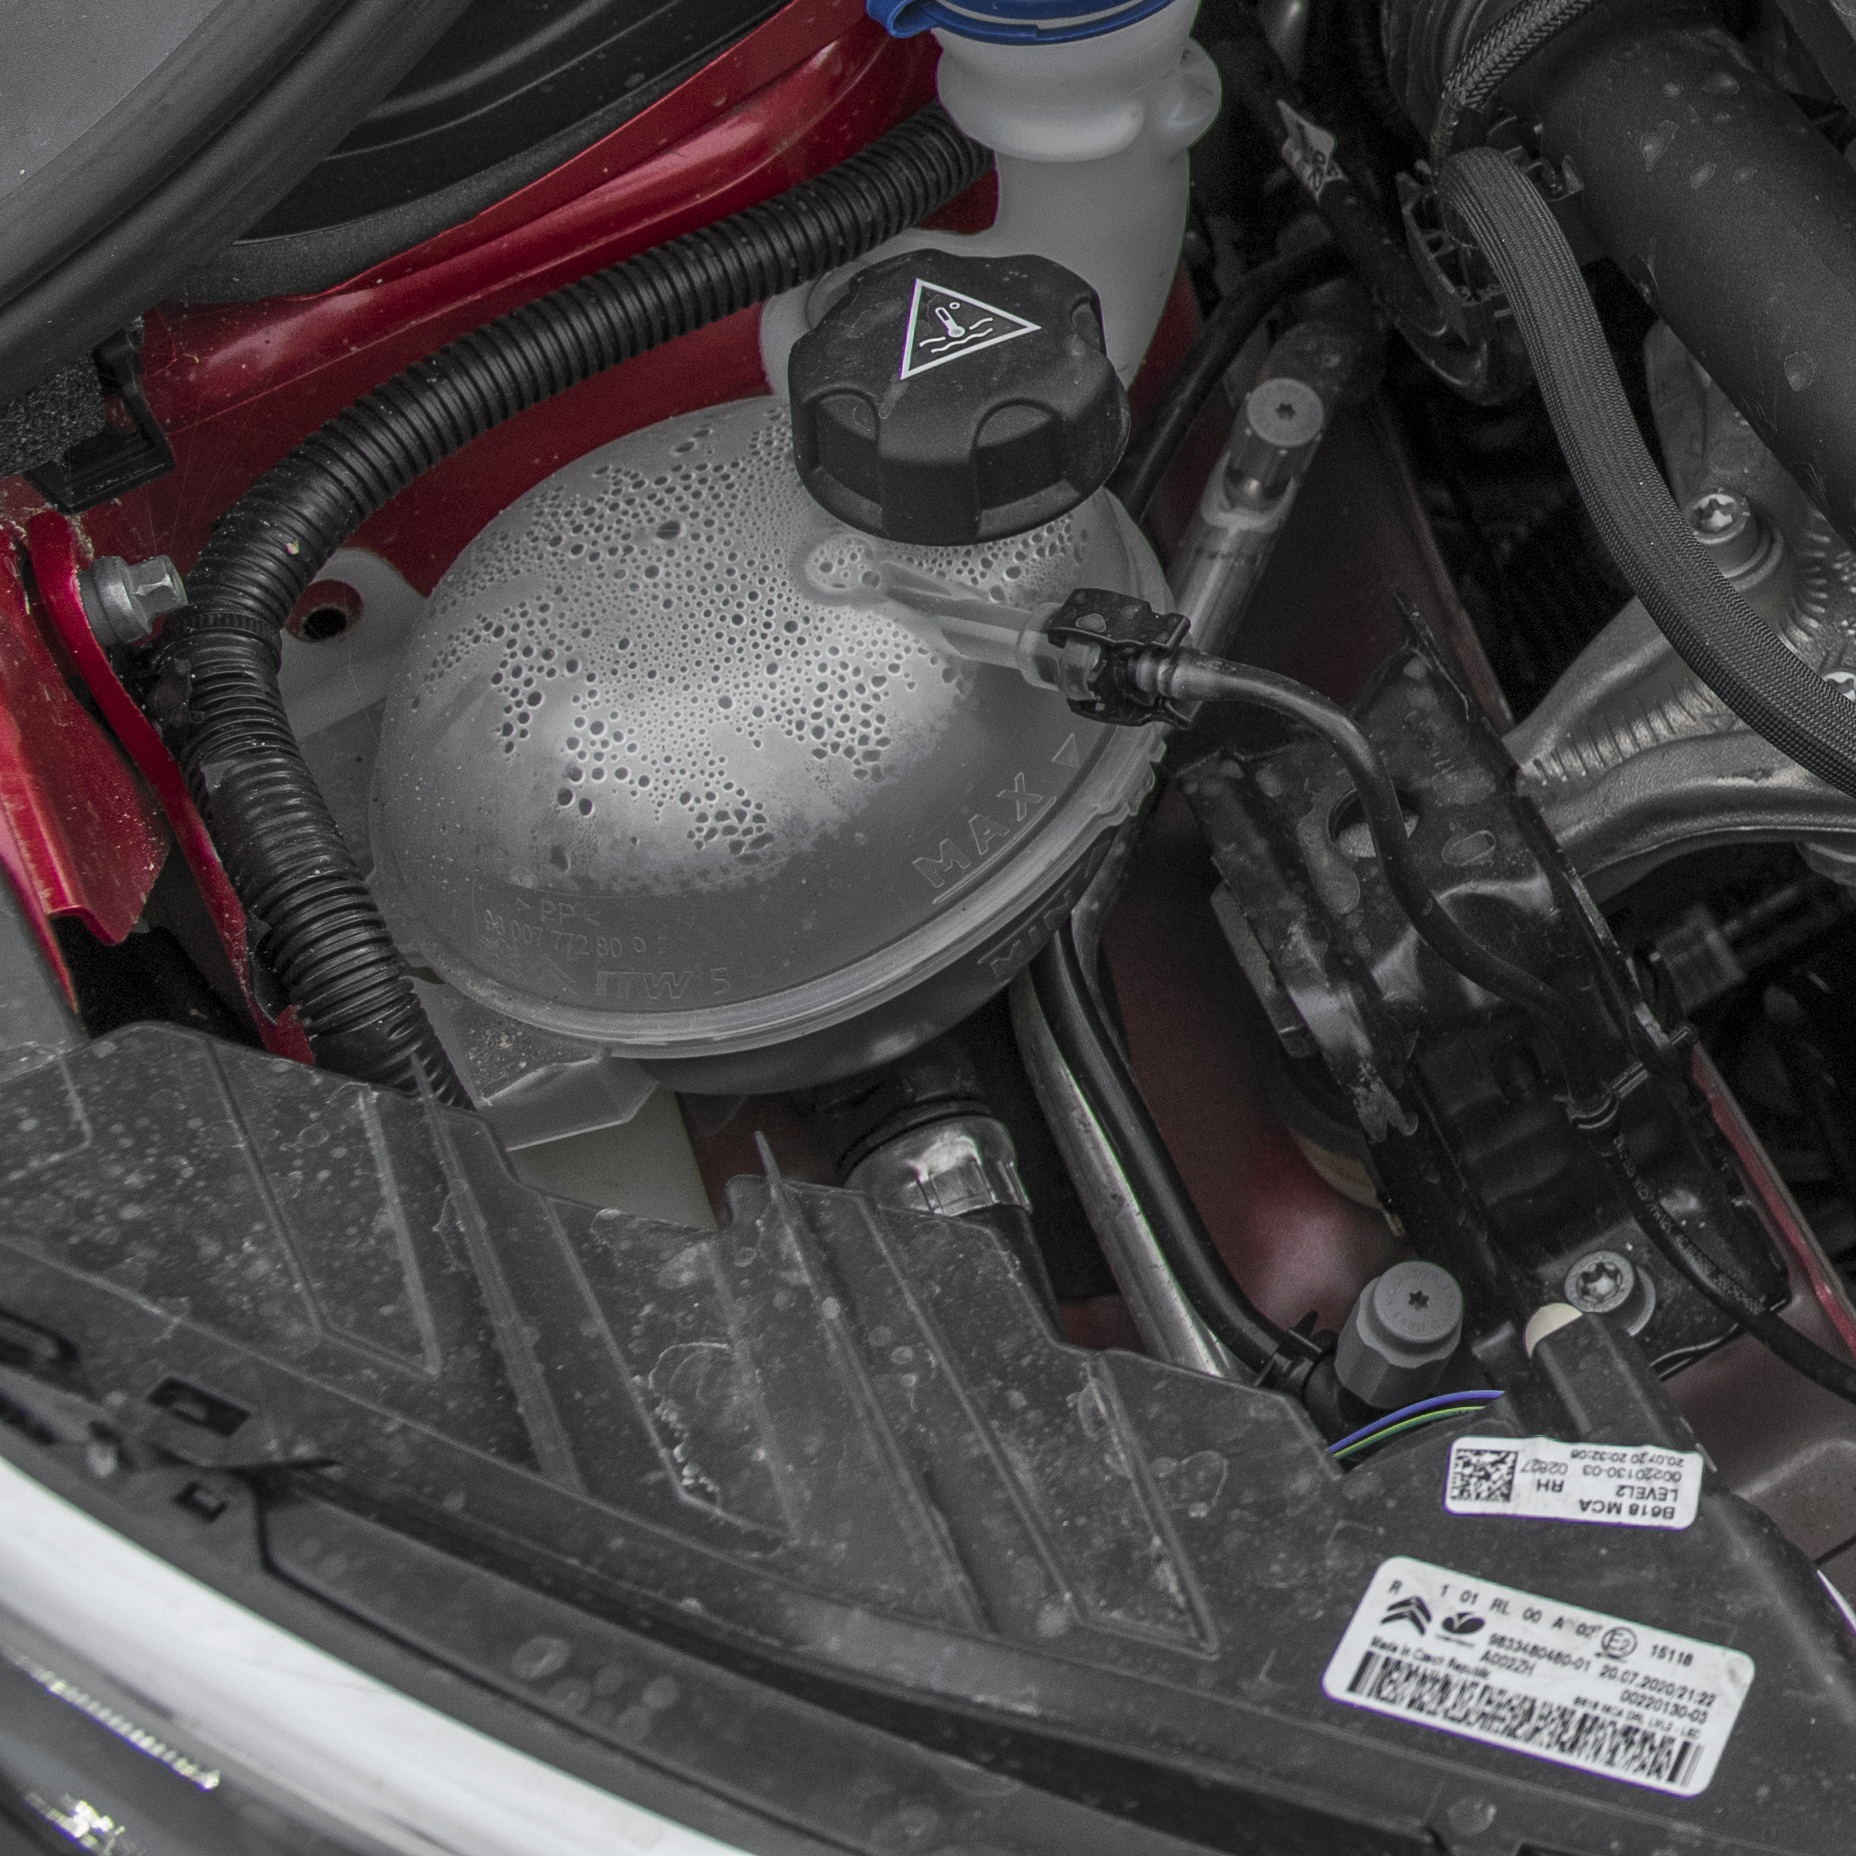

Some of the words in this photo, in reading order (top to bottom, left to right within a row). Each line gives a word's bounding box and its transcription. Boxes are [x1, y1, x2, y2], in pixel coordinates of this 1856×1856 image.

[911, 771, 1044, 889] MAX
[1536, 1478, 1565, 1493] RH
[1615, 1484, 1679, 1502] LEVEL2
[1578, 1498, 1623, 1515] MCA
[1628, 1503, 1676, 1520] B618
[1459, 1589, 1479, 1605] 01
[1489, 1597, 1511, 1616] RL
[1521, 1606, 1543, 1623] 00
[1552, 1615, 1564, 1629] A
[1370, 1635, 1399, 1653] Made
